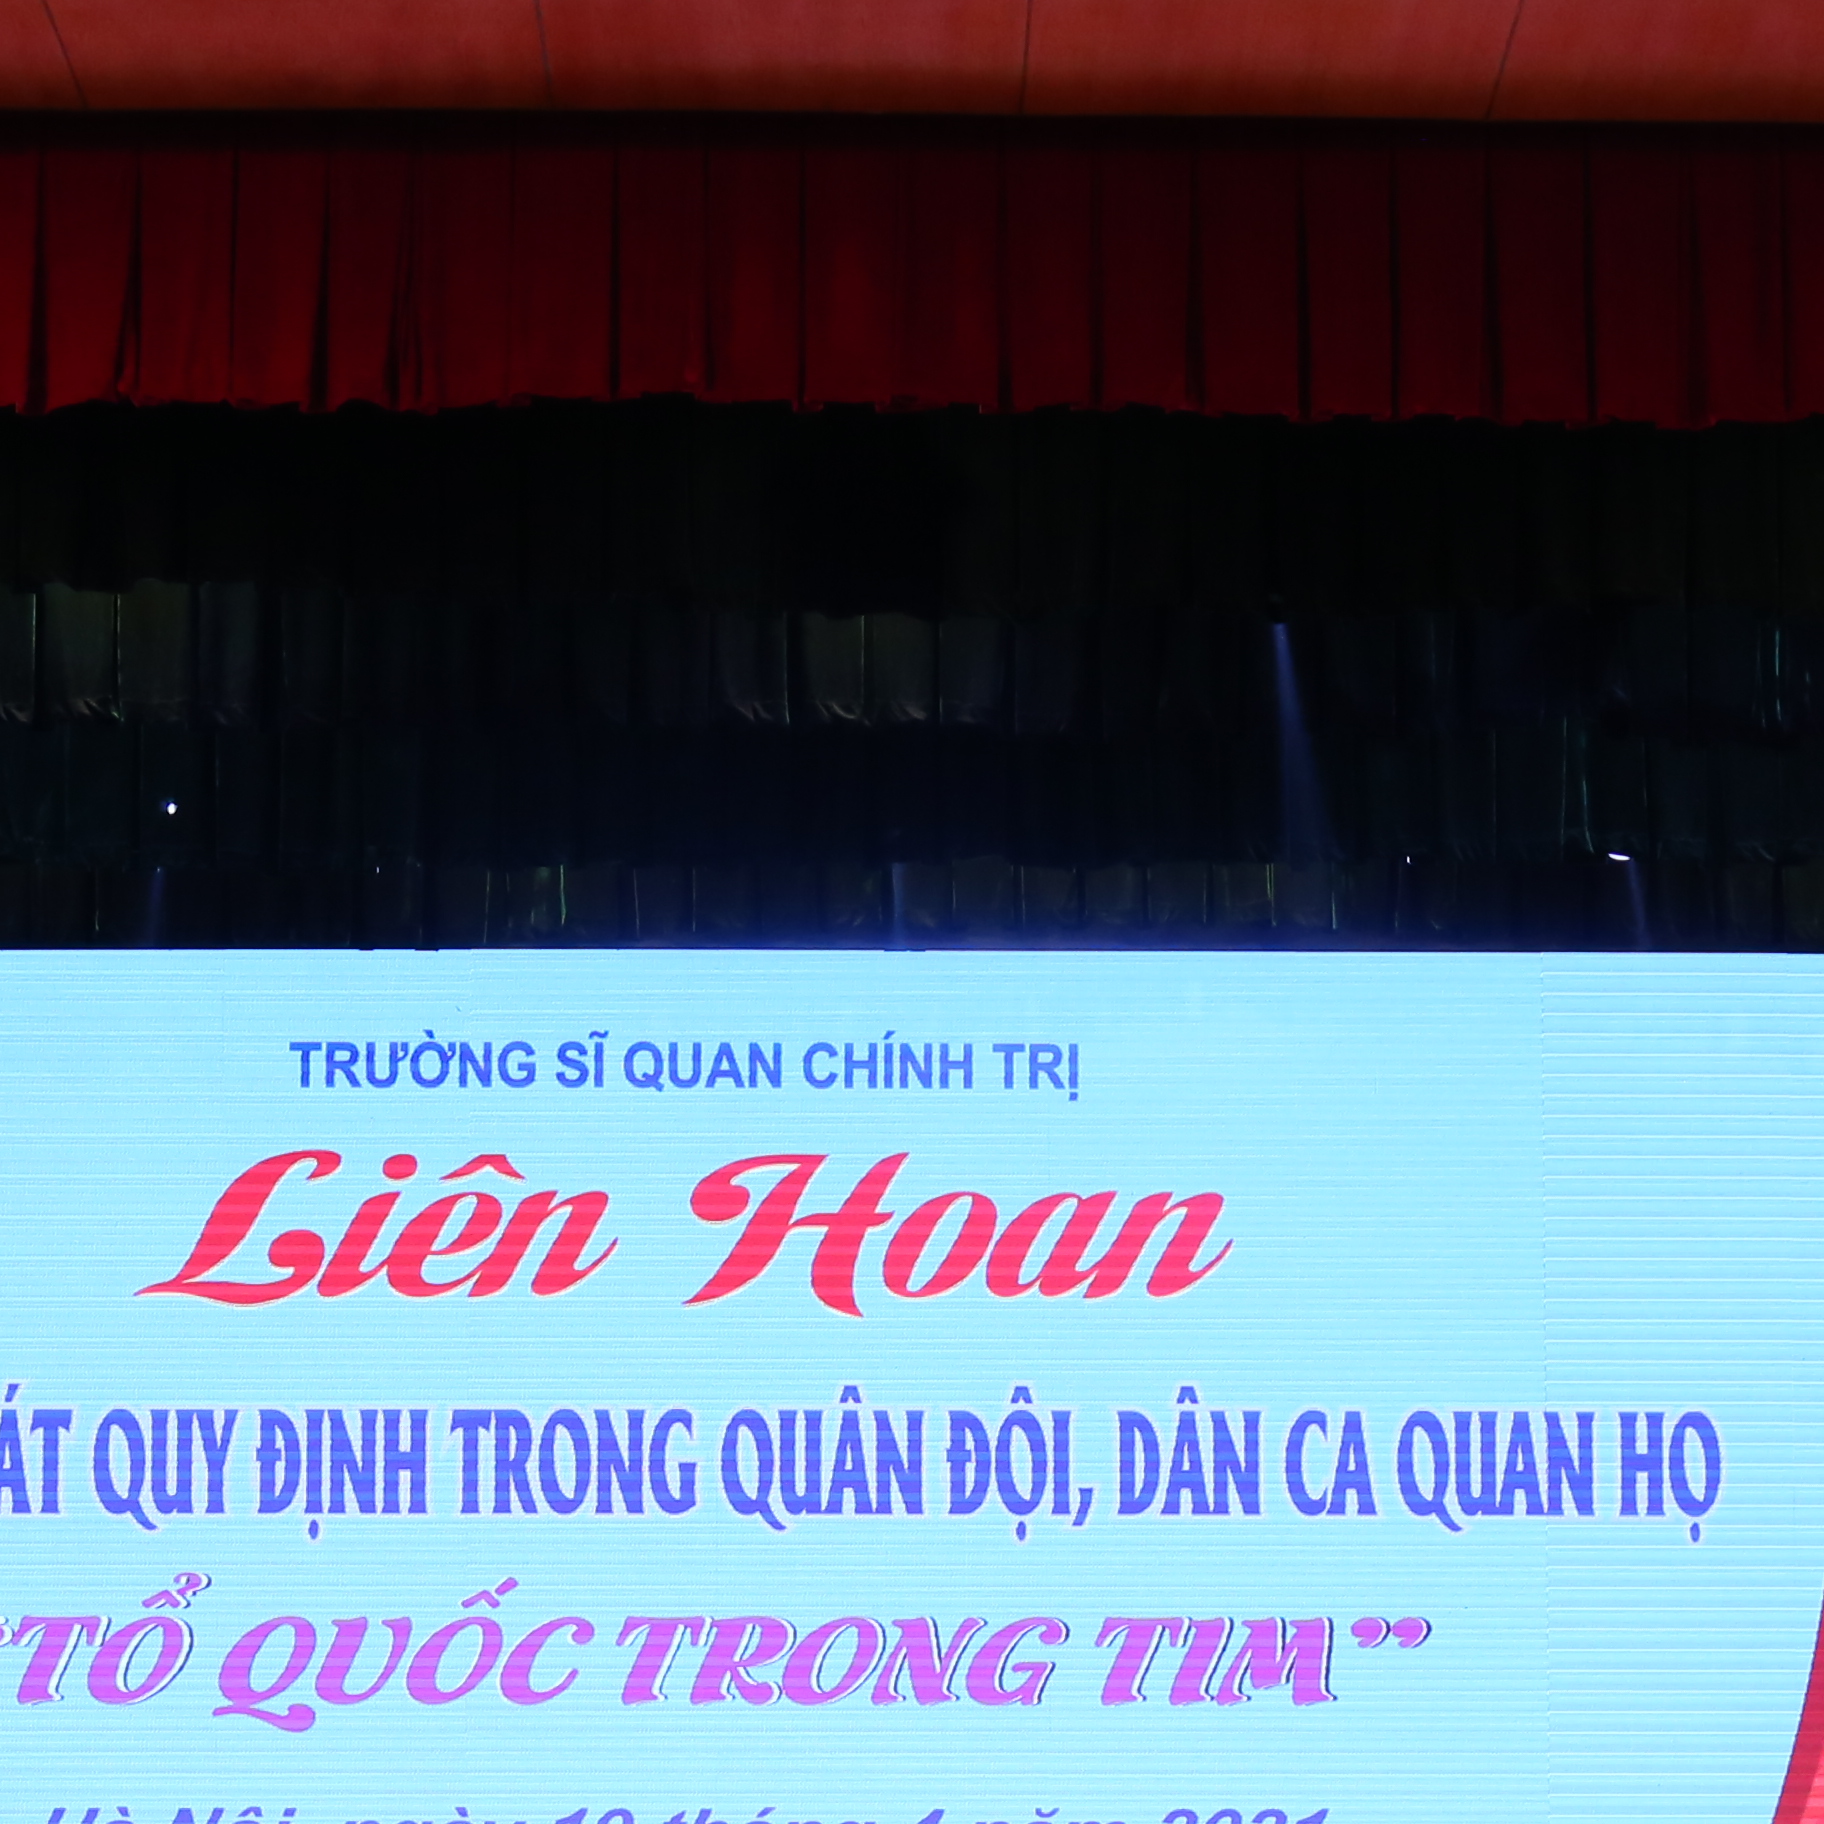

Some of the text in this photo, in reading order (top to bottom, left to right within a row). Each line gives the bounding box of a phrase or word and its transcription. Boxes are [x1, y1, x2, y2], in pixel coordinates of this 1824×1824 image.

[290, 1029, 1078, 1101] TRƯỜNG SĨ QUAN CHÍNH TRỊ
[134, 1150, 1233, 1317] Liên Hoan
[93, 1409, 239, 1531] QUY
[256, 1409, 428, 1540] ĐỊNH
[450, 1409, 697, 1515] TRONG
[721, 1385, 924, 1531] QUÂN
[946, 1386, 1094, 1541] ĐỘI,
[1118, 1386, 1261, 1515] DÂN
[1285, 1410, 1377, 1516] CA
[1397, 1411, 1595, 1532] QUAN
[1619, 1411, 1722, 1543] HỌ
[210, 1573, 595, 1733] QUỐC
[616, 1616, 1071, 1706] TRONG
